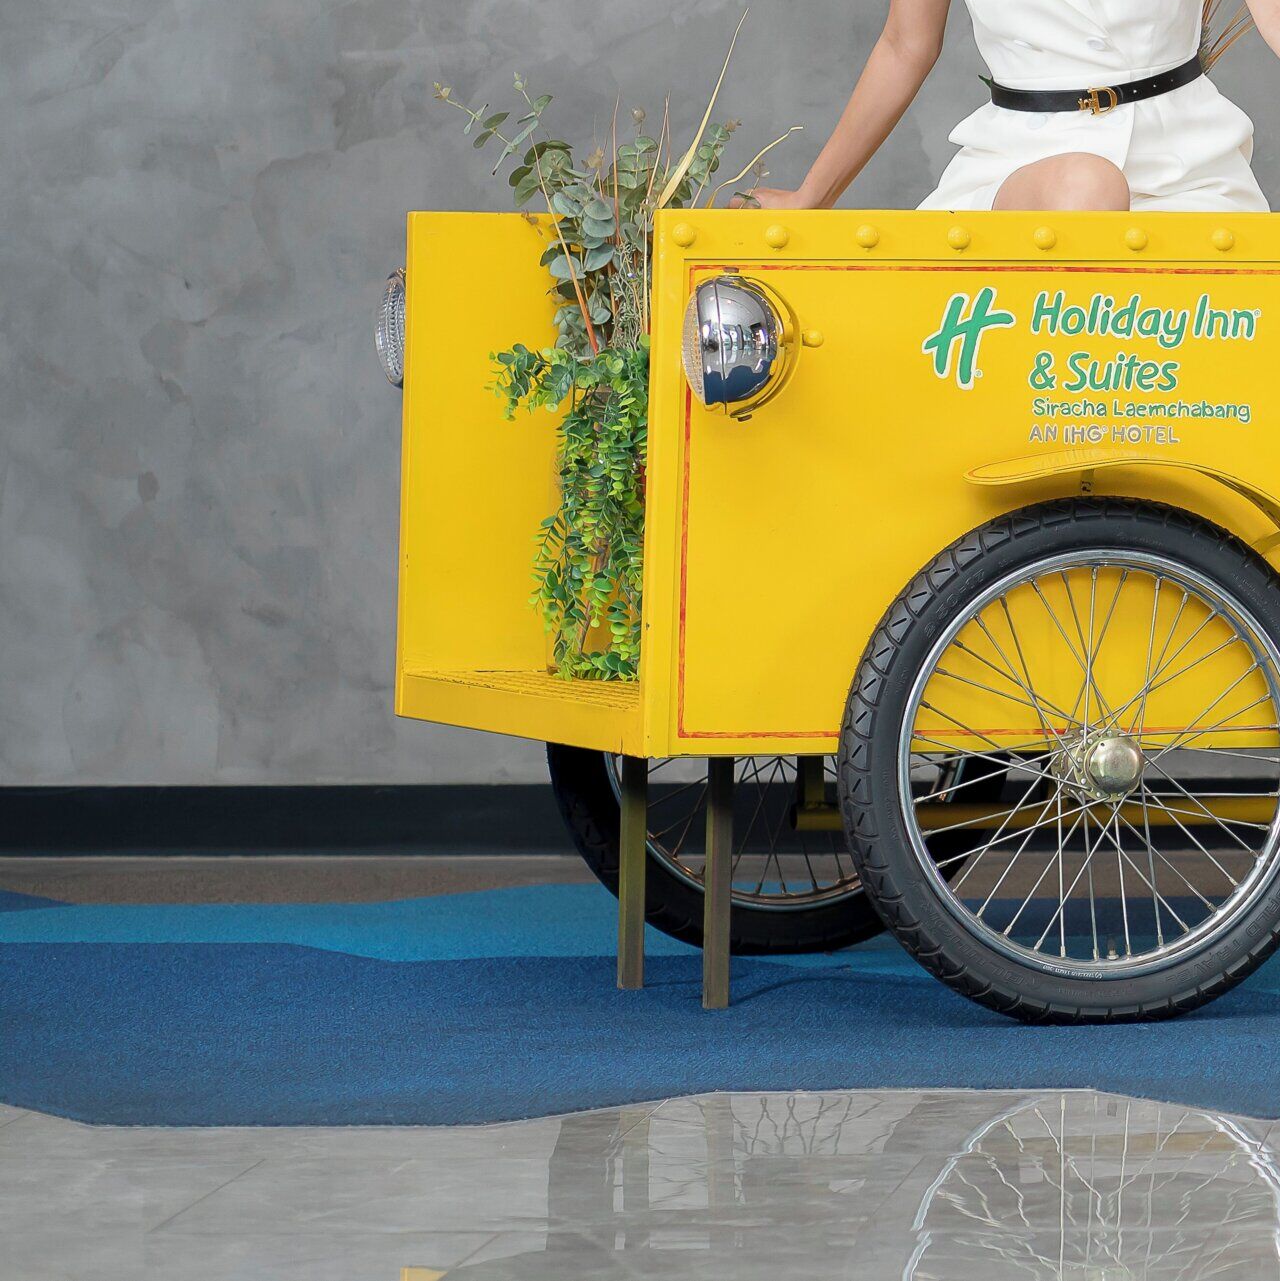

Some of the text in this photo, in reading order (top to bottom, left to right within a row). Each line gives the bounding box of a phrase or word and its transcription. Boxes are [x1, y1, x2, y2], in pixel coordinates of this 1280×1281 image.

[1031, 291, 1187, 349] Holiday
[1029, 351, 1179, 392] & Suites
[1033, 397, 1251, 423] Siracha Laemchabang
[1029, 423, 1058, 442] AN
[1112, 425, 1180, 445] HOTEL
